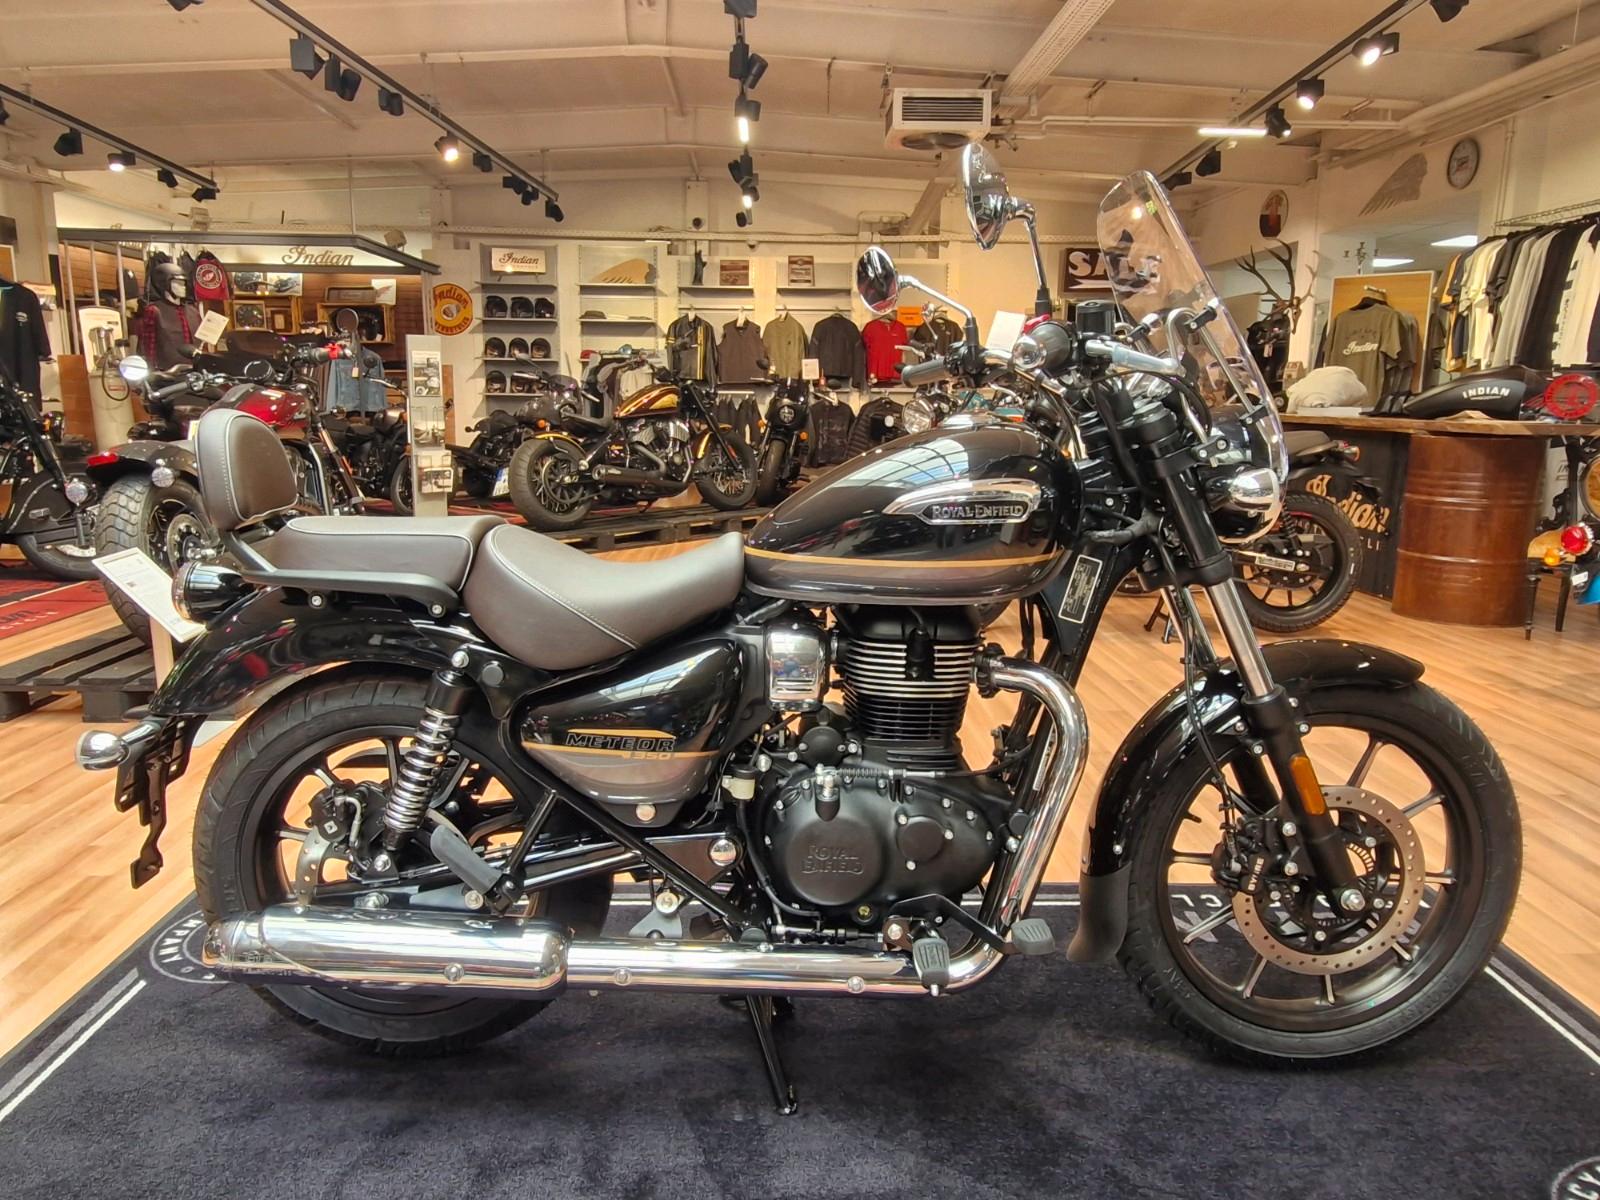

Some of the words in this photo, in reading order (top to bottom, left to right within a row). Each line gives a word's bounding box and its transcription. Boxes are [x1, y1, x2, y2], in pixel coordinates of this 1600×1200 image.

[281, 245, 354, 265] Indian
[498, 252, 540, 265] Indian
[1462, 386, 1511, 399] INDIAN
[931, 505, 974, 519] ROYAL
[975, 504, 1024, 519] ENFIELD
[565, 732, 676, 752] METEOR
[807, 844, 860, 861] ROYAL
[801, 859, 865, 875] ENFIELD
